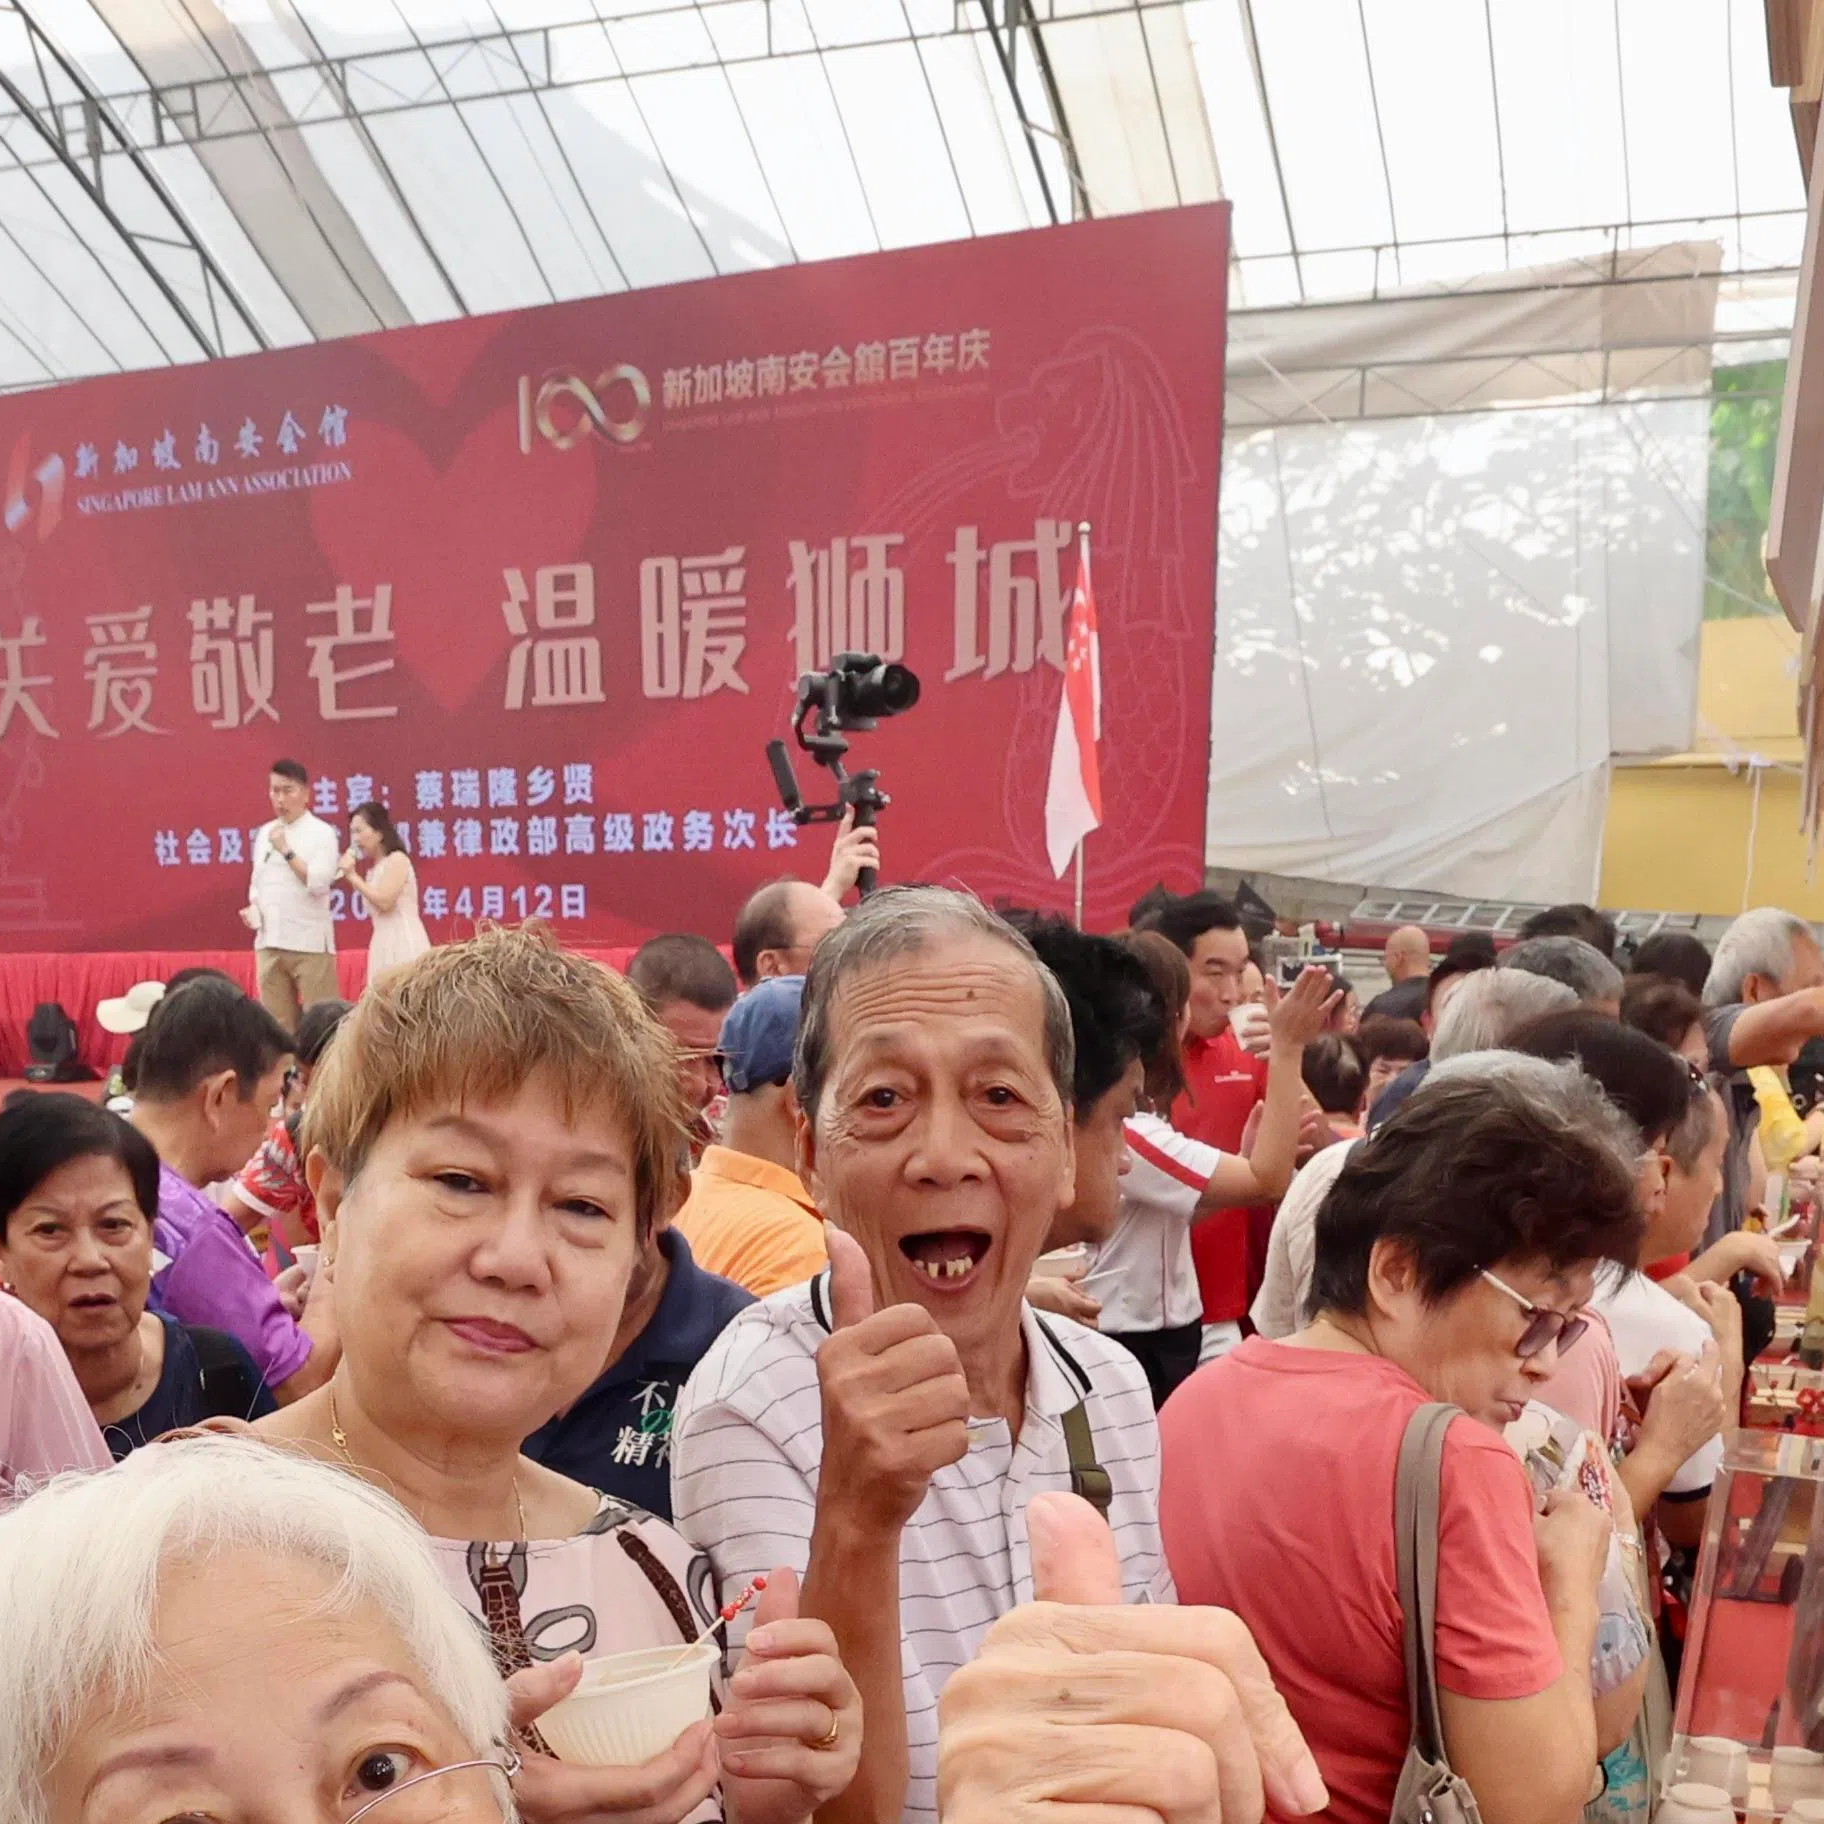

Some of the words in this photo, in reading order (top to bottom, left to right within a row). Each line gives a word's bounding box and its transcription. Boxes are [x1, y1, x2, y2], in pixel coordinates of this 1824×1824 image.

[77, 484, 165, 515] SINGAPORE
[167, 478, 203, 506] LAM
[205, 474, 239, 501] ANN
[243, 460, 352, 496] ASSOCIATION
[501, 518, 1073, 710] 温暖狮城
[328, 883, 586, 922] 20年4月12日
